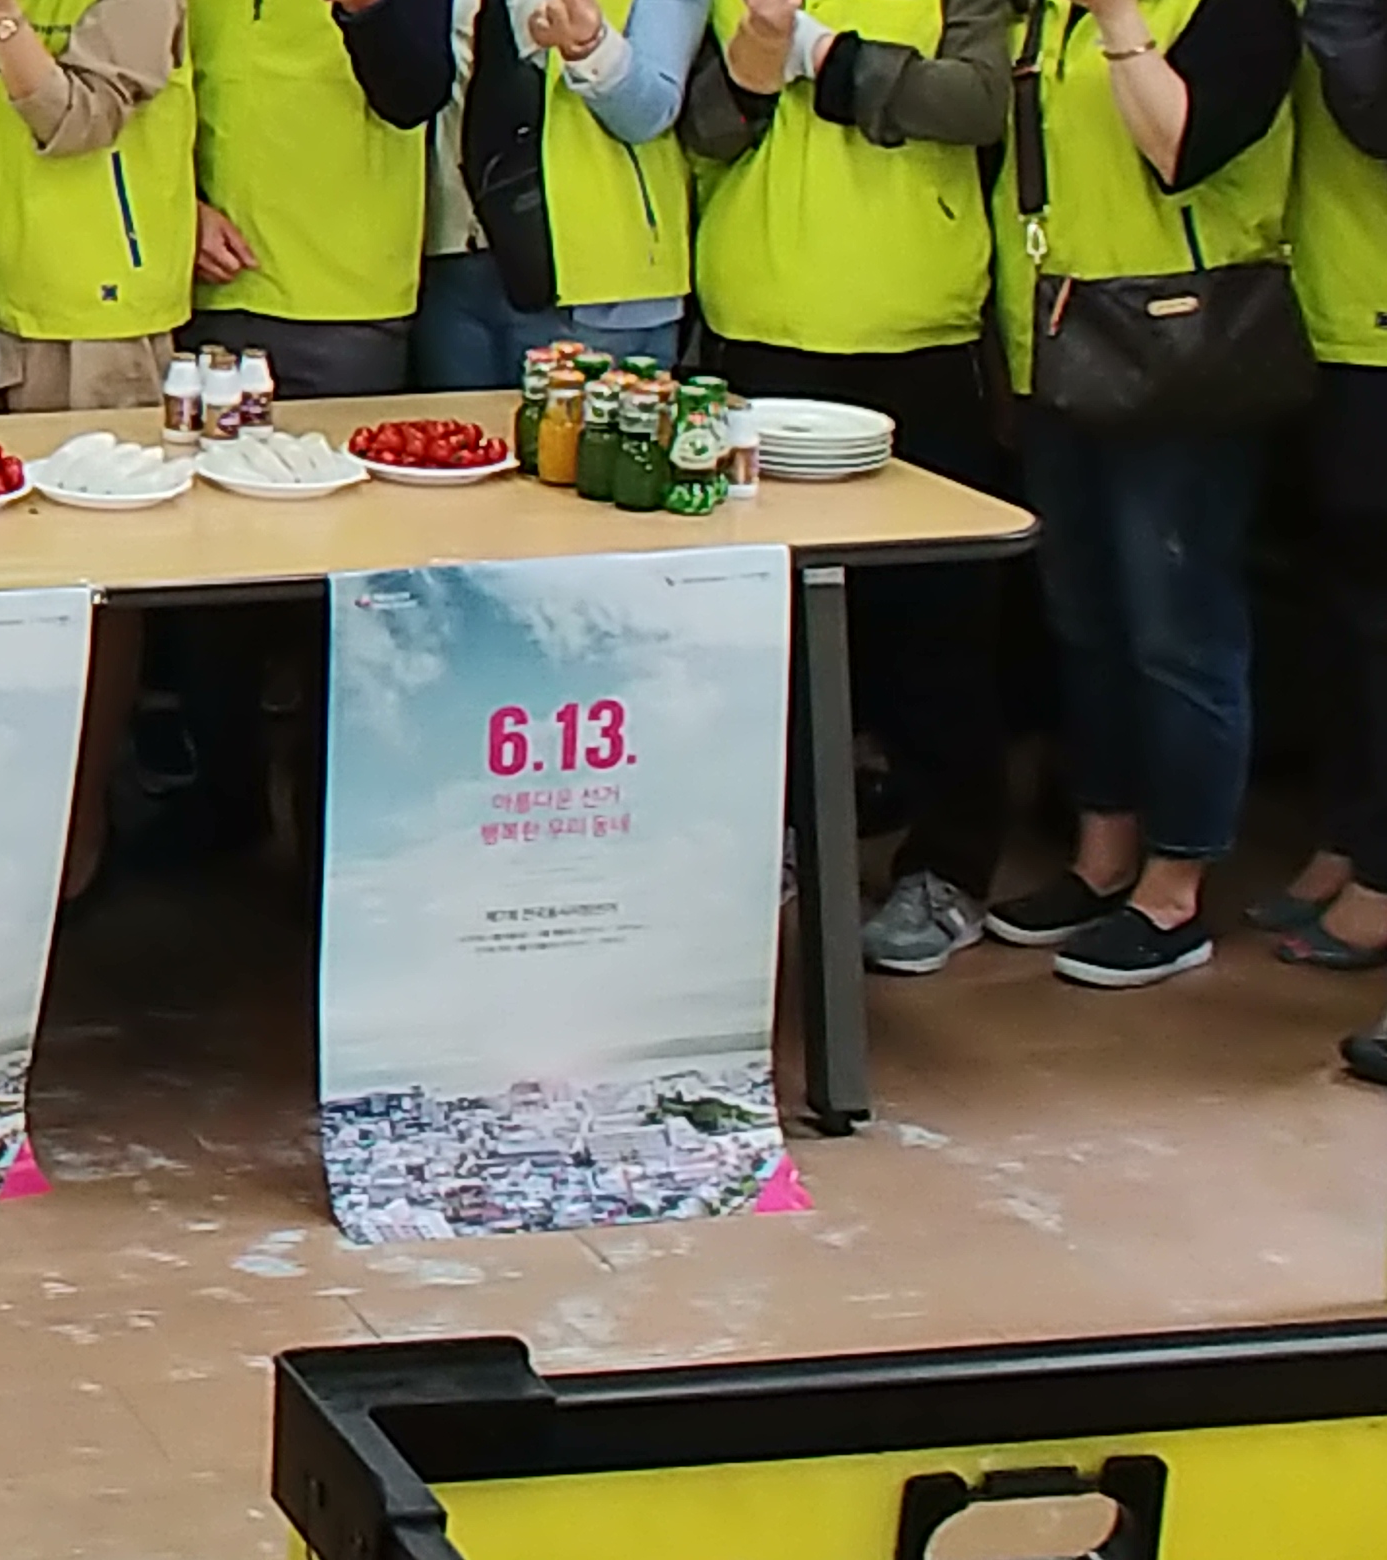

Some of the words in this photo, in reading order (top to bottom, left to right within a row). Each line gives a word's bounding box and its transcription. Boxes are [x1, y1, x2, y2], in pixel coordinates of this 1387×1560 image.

[492, 788, 573, 814] 아름다운
[583, 784, 620, 808] 선거
[549, 817, 587, 839] 우리
